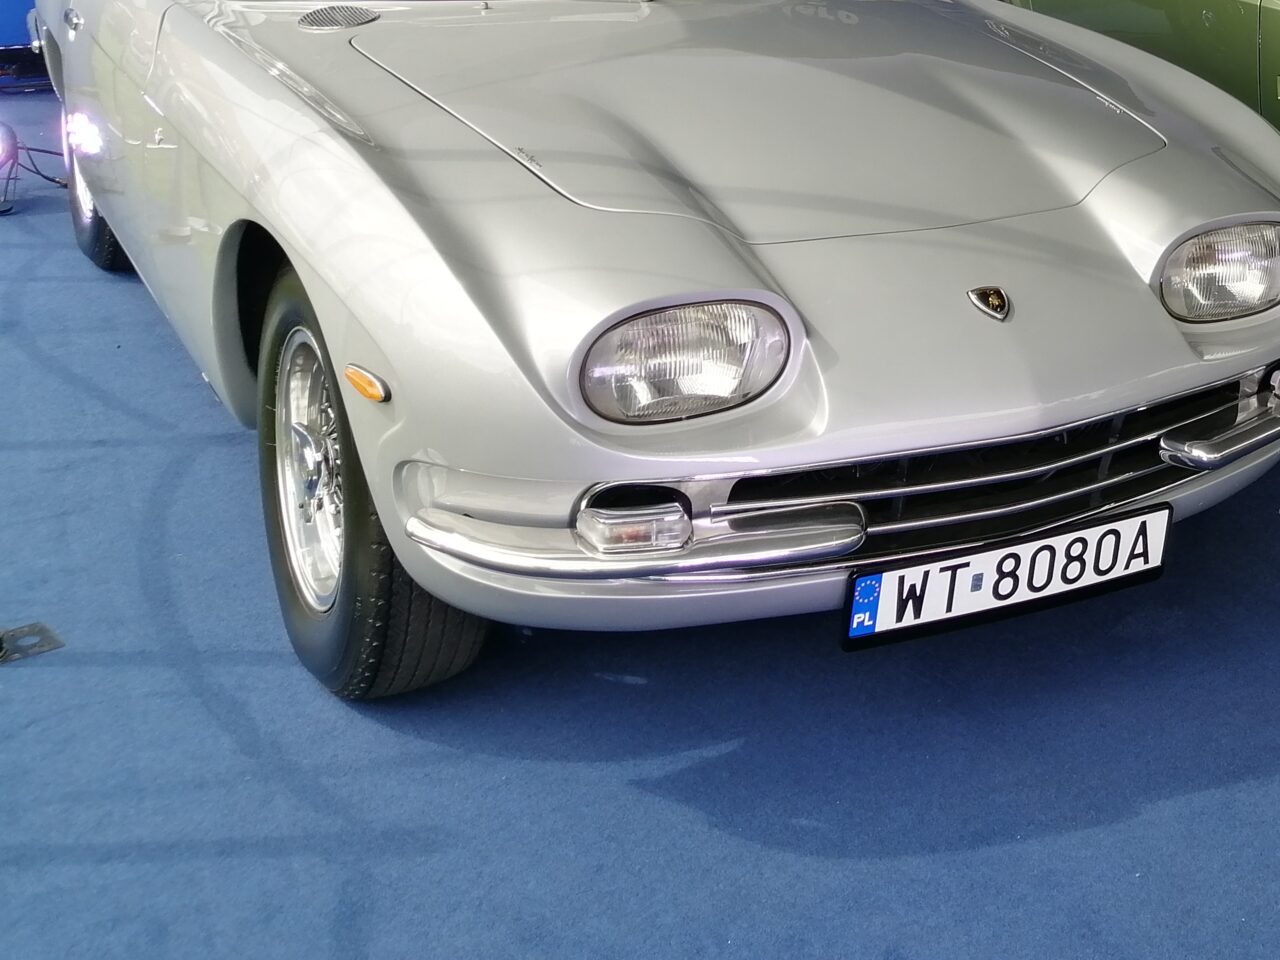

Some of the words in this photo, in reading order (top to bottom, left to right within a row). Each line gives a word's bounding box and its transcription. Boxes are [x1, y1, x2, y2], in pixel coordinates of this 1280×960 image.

[895, 561, 971, 625] WT
[991, 520, 1151, 602] 8080A
[852, 613, 873, 628] PL
